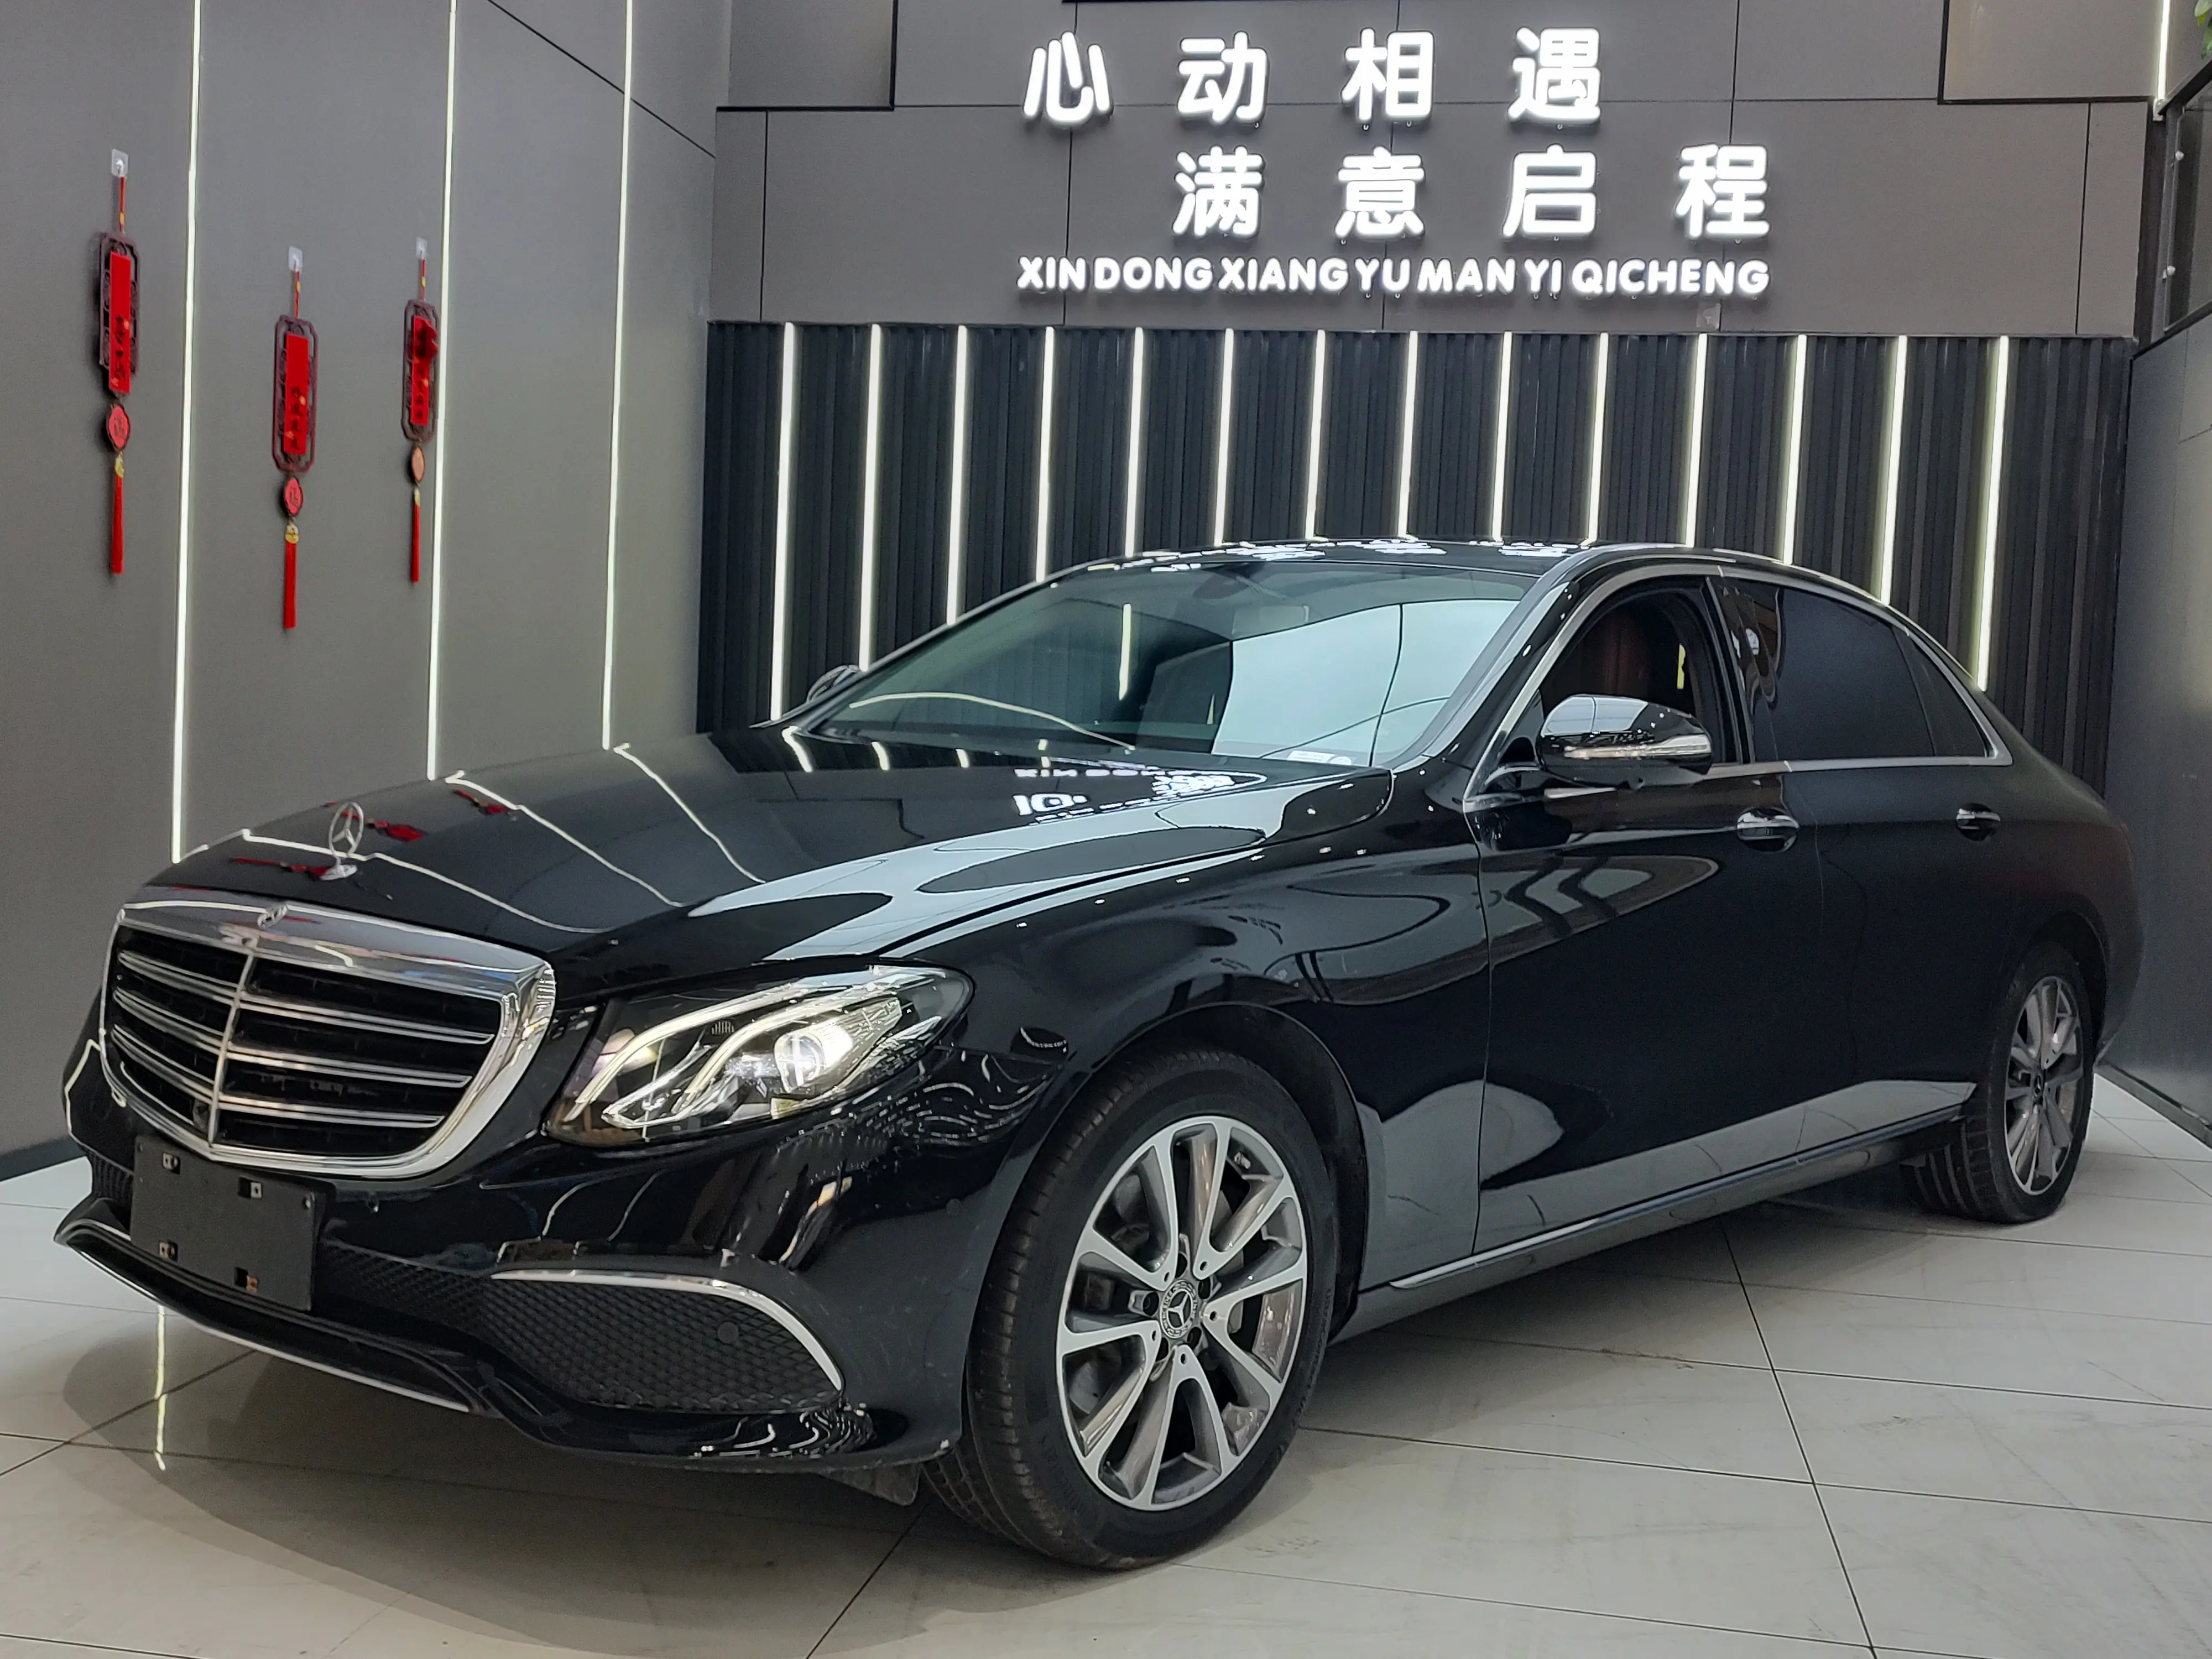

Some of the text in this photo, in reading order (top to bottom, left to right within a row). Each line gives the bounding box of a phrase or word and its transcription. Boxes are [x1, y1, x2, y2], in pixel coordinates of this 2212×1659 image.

[1022, 28, 1600, 122] 心动相遇
[1173, 144, 1769, 237] 满意启程
[1018, 257, 1086, 289] XIN
[1095, 257, 1213, 289] DONG
[1218, 257, 1348, 290] XIANG
[1354, 258, 1410, 291] YU
[1417, 259, 1515, 292] MAN
[1524, 259, 1562, 293] YI
